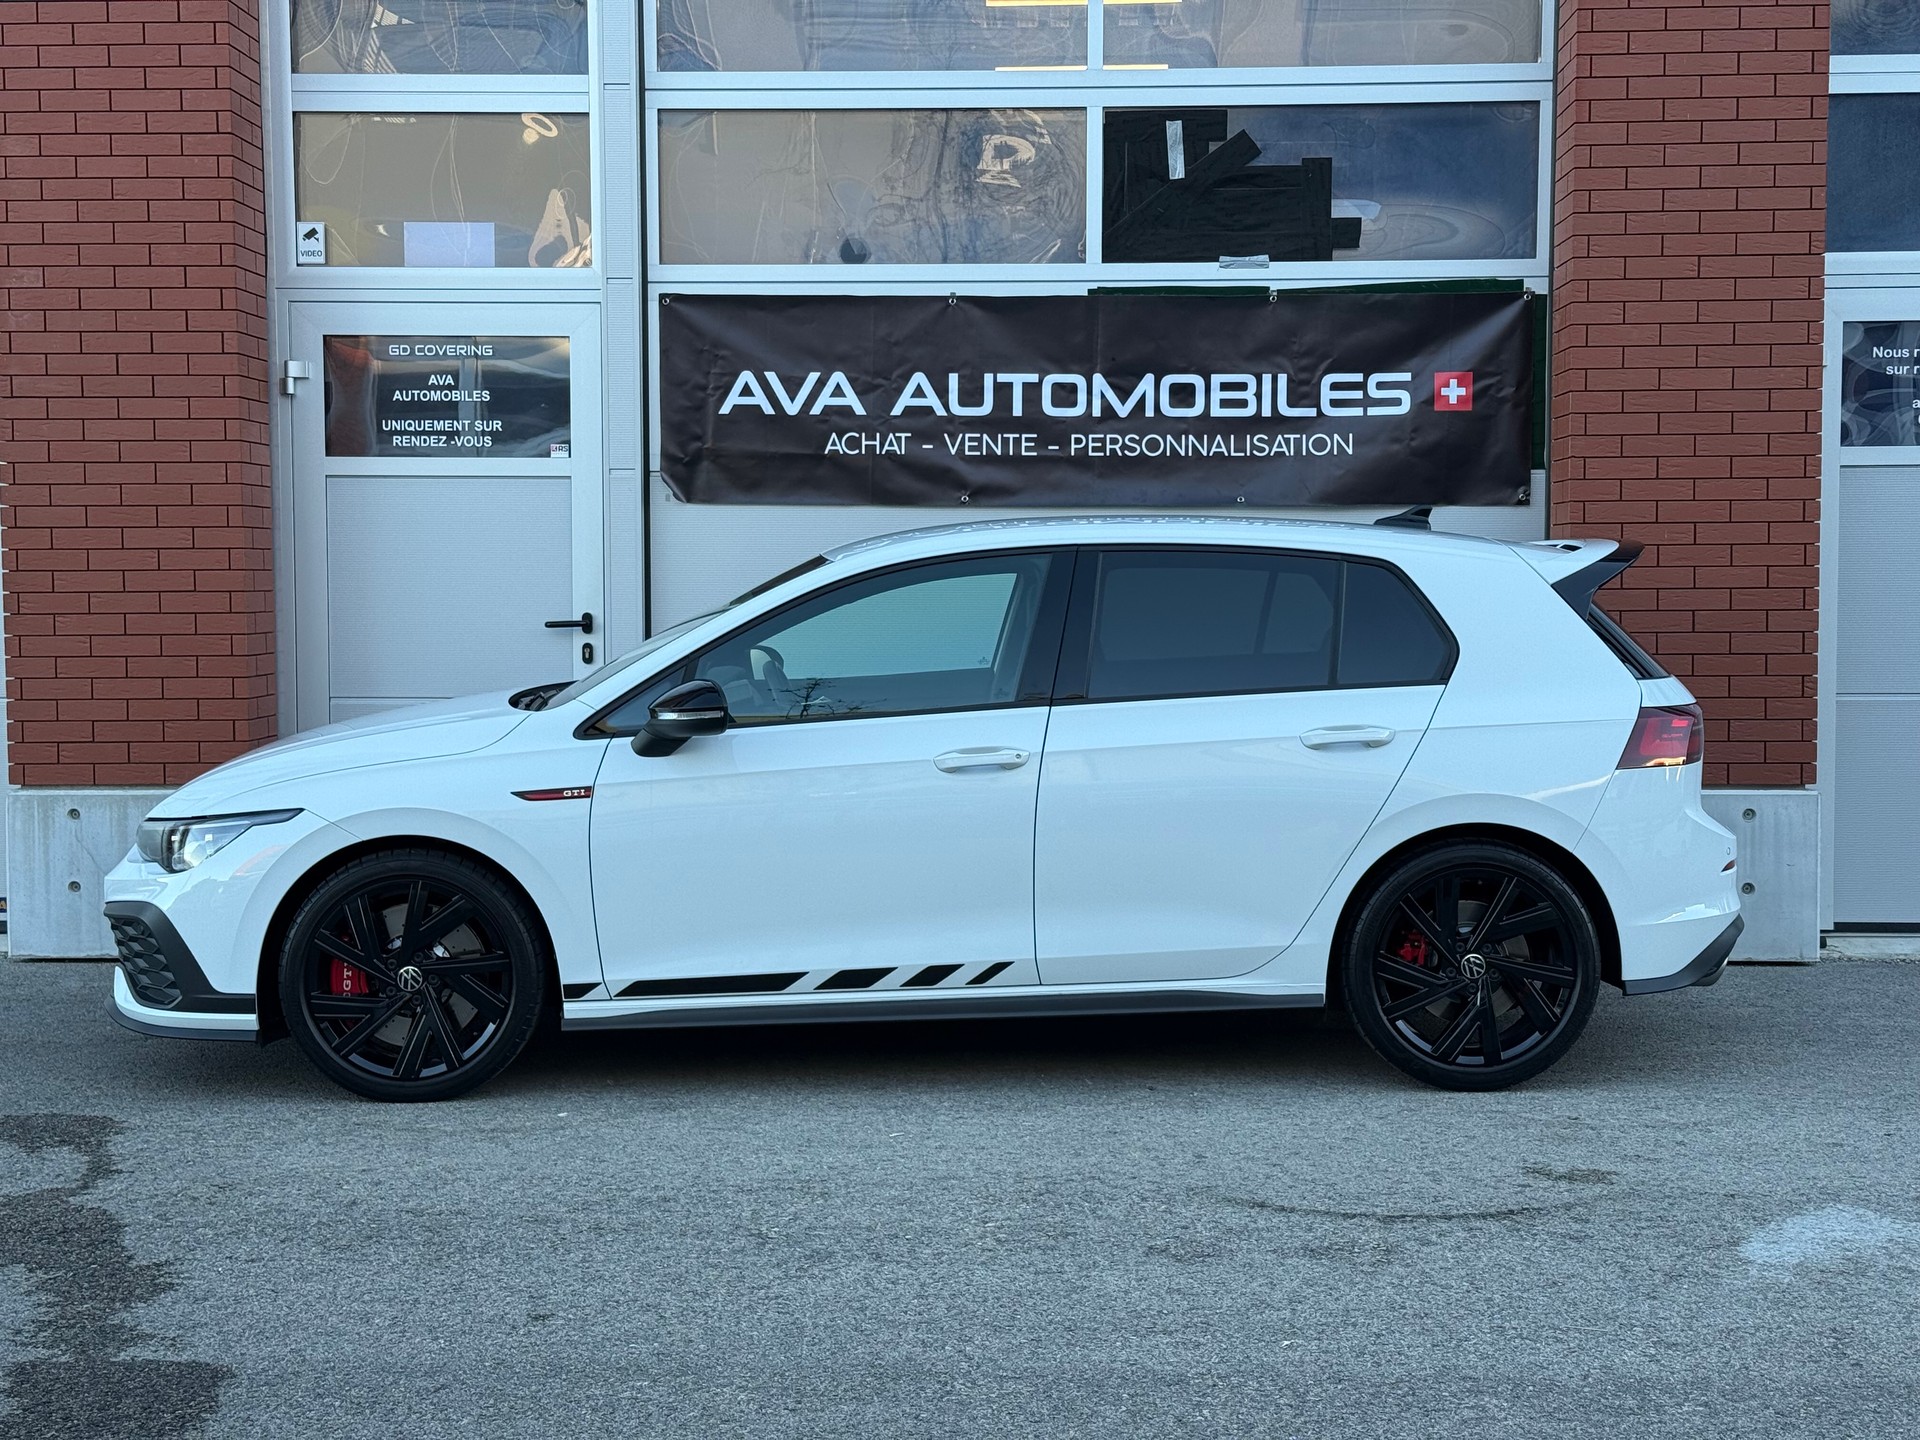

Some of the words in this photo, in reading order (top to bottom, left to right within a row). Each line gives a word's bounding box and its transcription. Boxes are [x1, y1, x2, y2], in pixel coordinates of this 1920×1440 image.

[300, 249, 323, 258] VIDEO
[388, 344, 411, 356] GD
[415, 344, 493, 356] COVERING
[1872, 346, 1910, 358] Nous
[1885, 365, 1910, 375] sur
[427, 374, 455, 386] AVA
[392, 389, 491, 402] AUTOMOBILES
[717, 369, 867, 417] AVA
[889, 371, 1413, 418] AUTOMOBILES
[382, 420, 471, 432] UNIQUEMENT
[474, 420, 503, 432] SUR
[392, 435, 448, 447] RENDEZ
[824, 432, 912, 455] ACHAT
[943, 432, 1038, 456] VENTE
[1069, 432, 1354, 457] PERSONNALISATION
[563, 789, 586, 797] GTI
